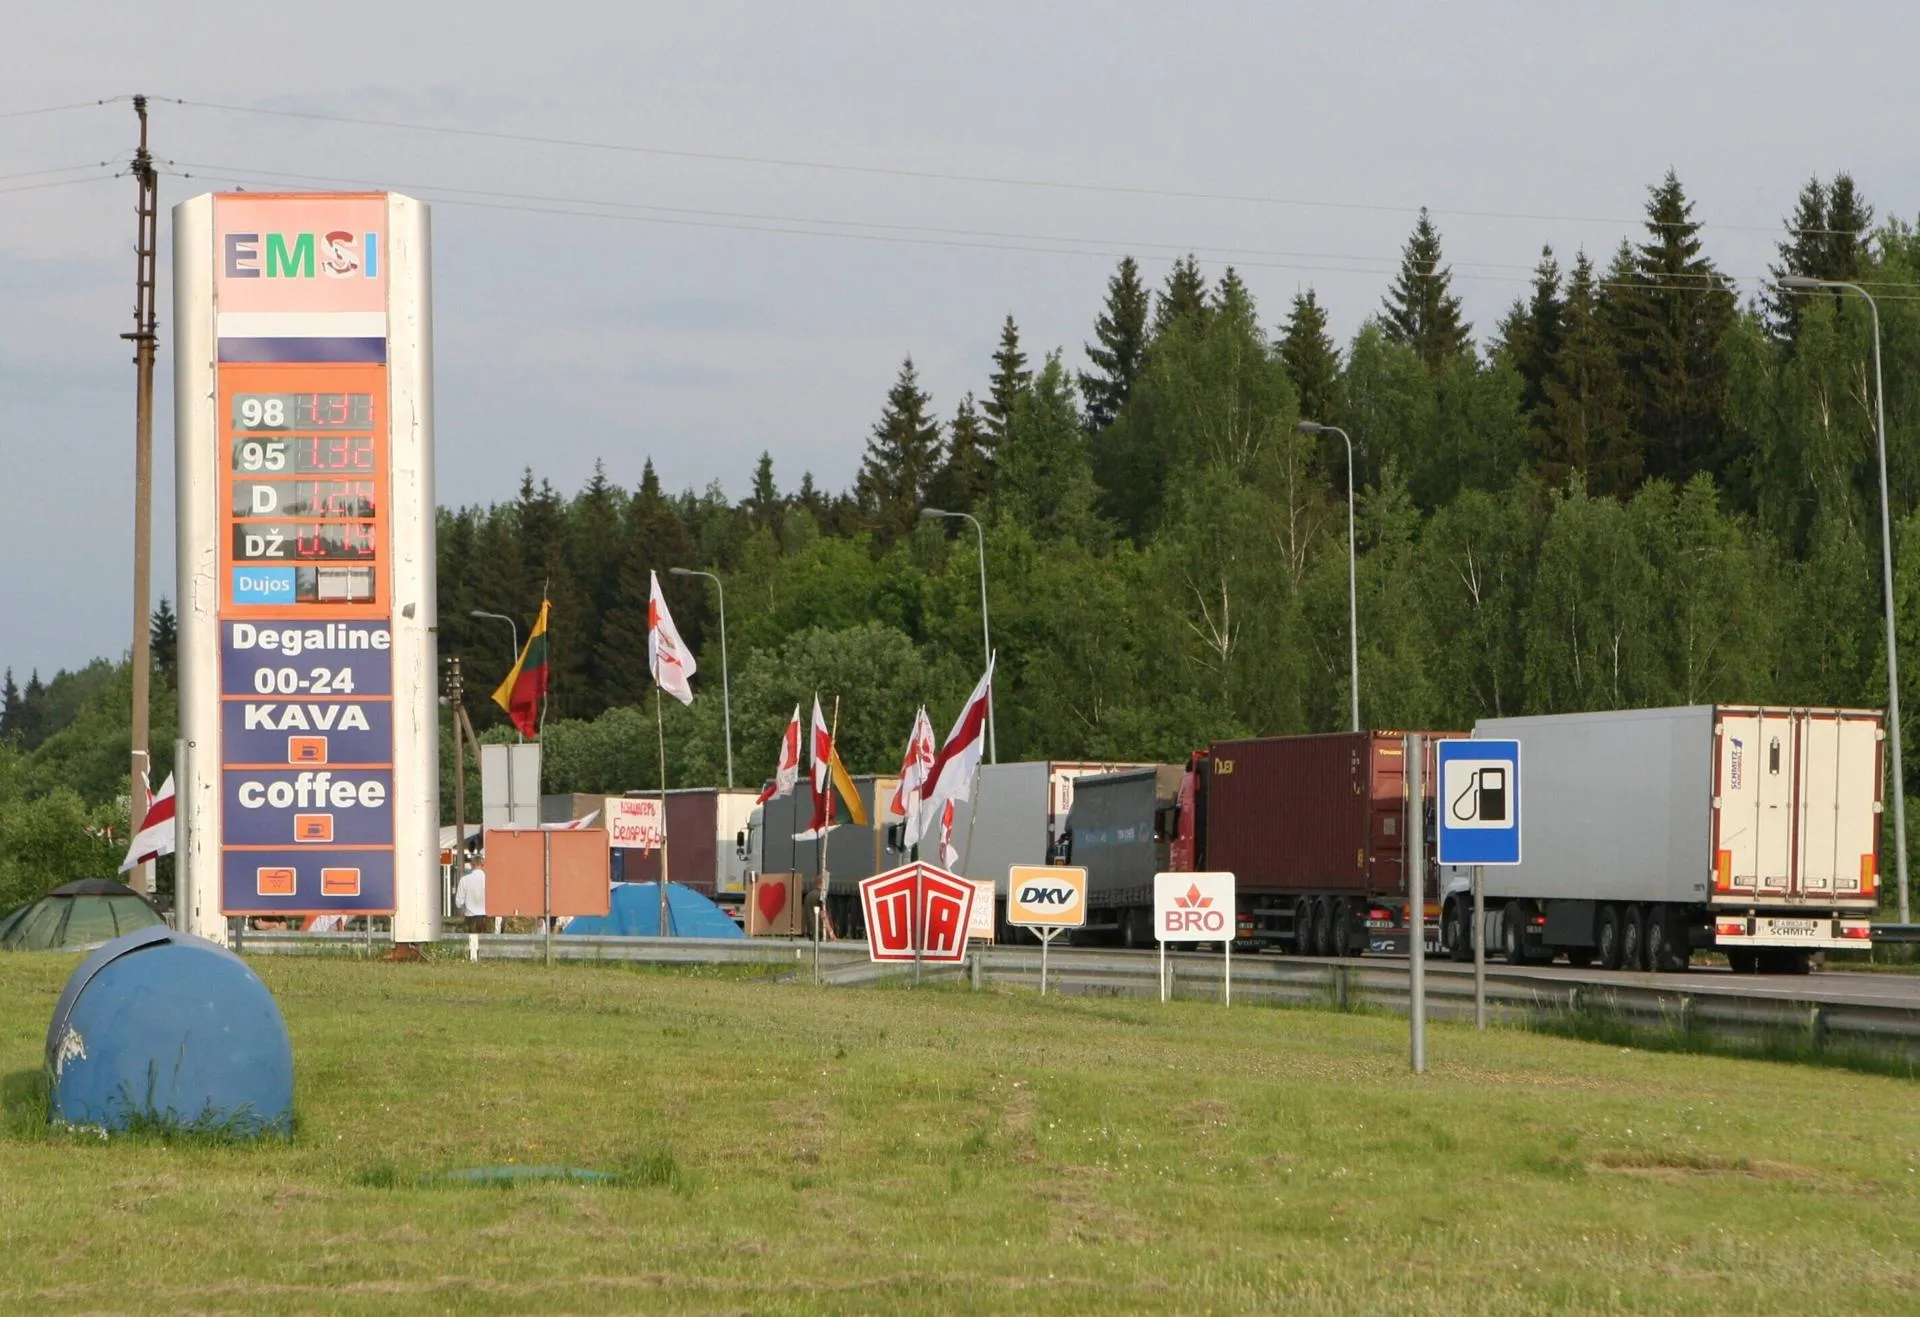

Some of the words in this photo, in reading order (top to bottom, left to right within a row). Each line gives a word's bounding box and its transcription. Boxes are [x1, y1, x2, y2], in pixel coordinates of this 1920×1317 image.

[224, 231, 378, 279] EMSI
[242, 399, 285, 427] 98
[242, 442, 286, 471] 95
[252, 485, 278, 514] D
[245, 528, 285, 557] DŽ
[239, 577, 290, 596] Dujos
[232, 623, 391, 656] Degaline
[254, 667, 354, 694] 00-24
[244, 704, 370, 731] KAVA
[238, 772, 386, 808] coffee
[1020, 888, 1074, 904] DKV
[1165, 911, 1225, 932] BRO
[1770, 927, 1816, 936] SCHMITZ
